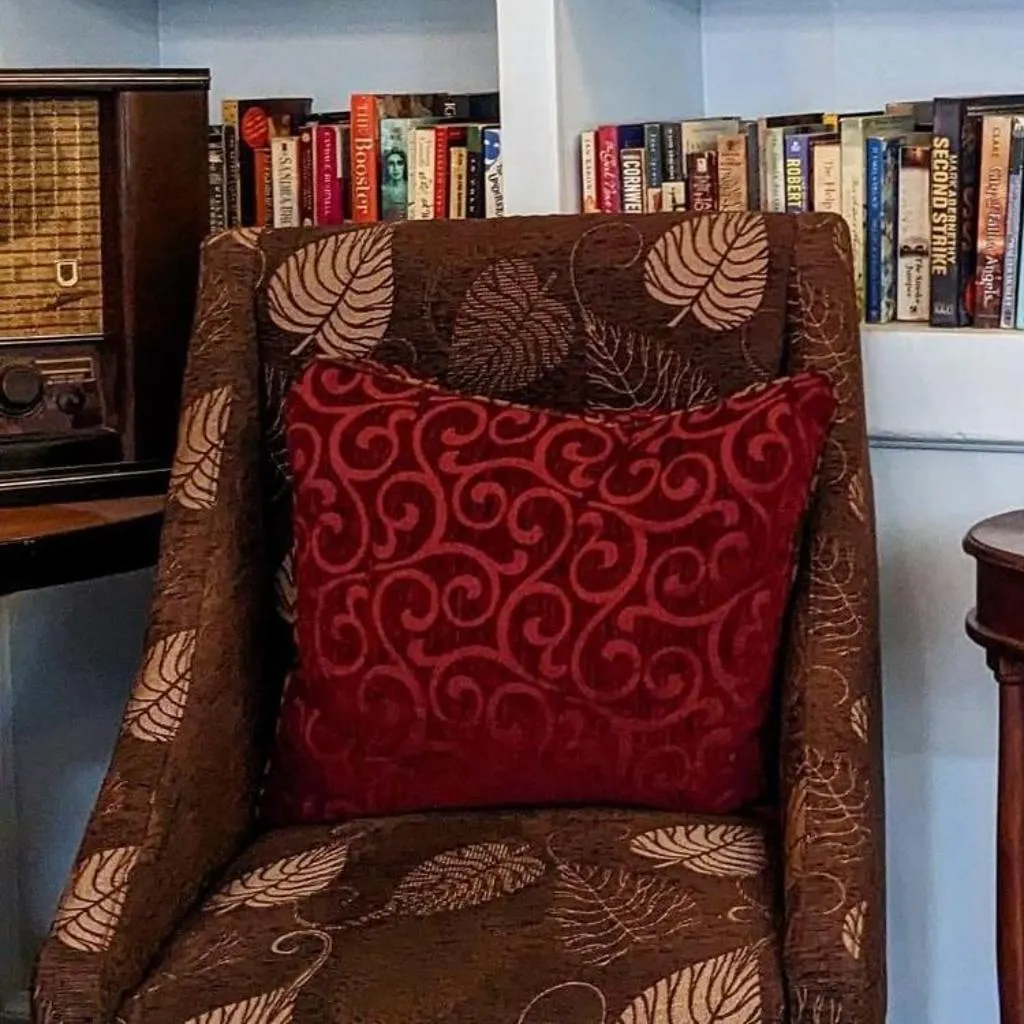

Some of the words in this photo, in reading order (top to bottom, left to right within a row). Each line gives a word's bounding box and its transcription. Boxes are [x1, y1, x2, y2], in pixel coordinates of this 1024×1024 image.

[279, 155, 294, 202] SANDRA
[354, 135, 374, 214] Booster
[786, 159, 800, 207] ROBERT
[932, 137, 949, 208] SECOND
[948, 155, 958, 188] MARK
[822, 182, 835, 210] Help
[932, 212, 947, 276] STRIKE
[947, 191, 957, 264] ABERNETHY
[976, 256, 1000, 300] Angels
